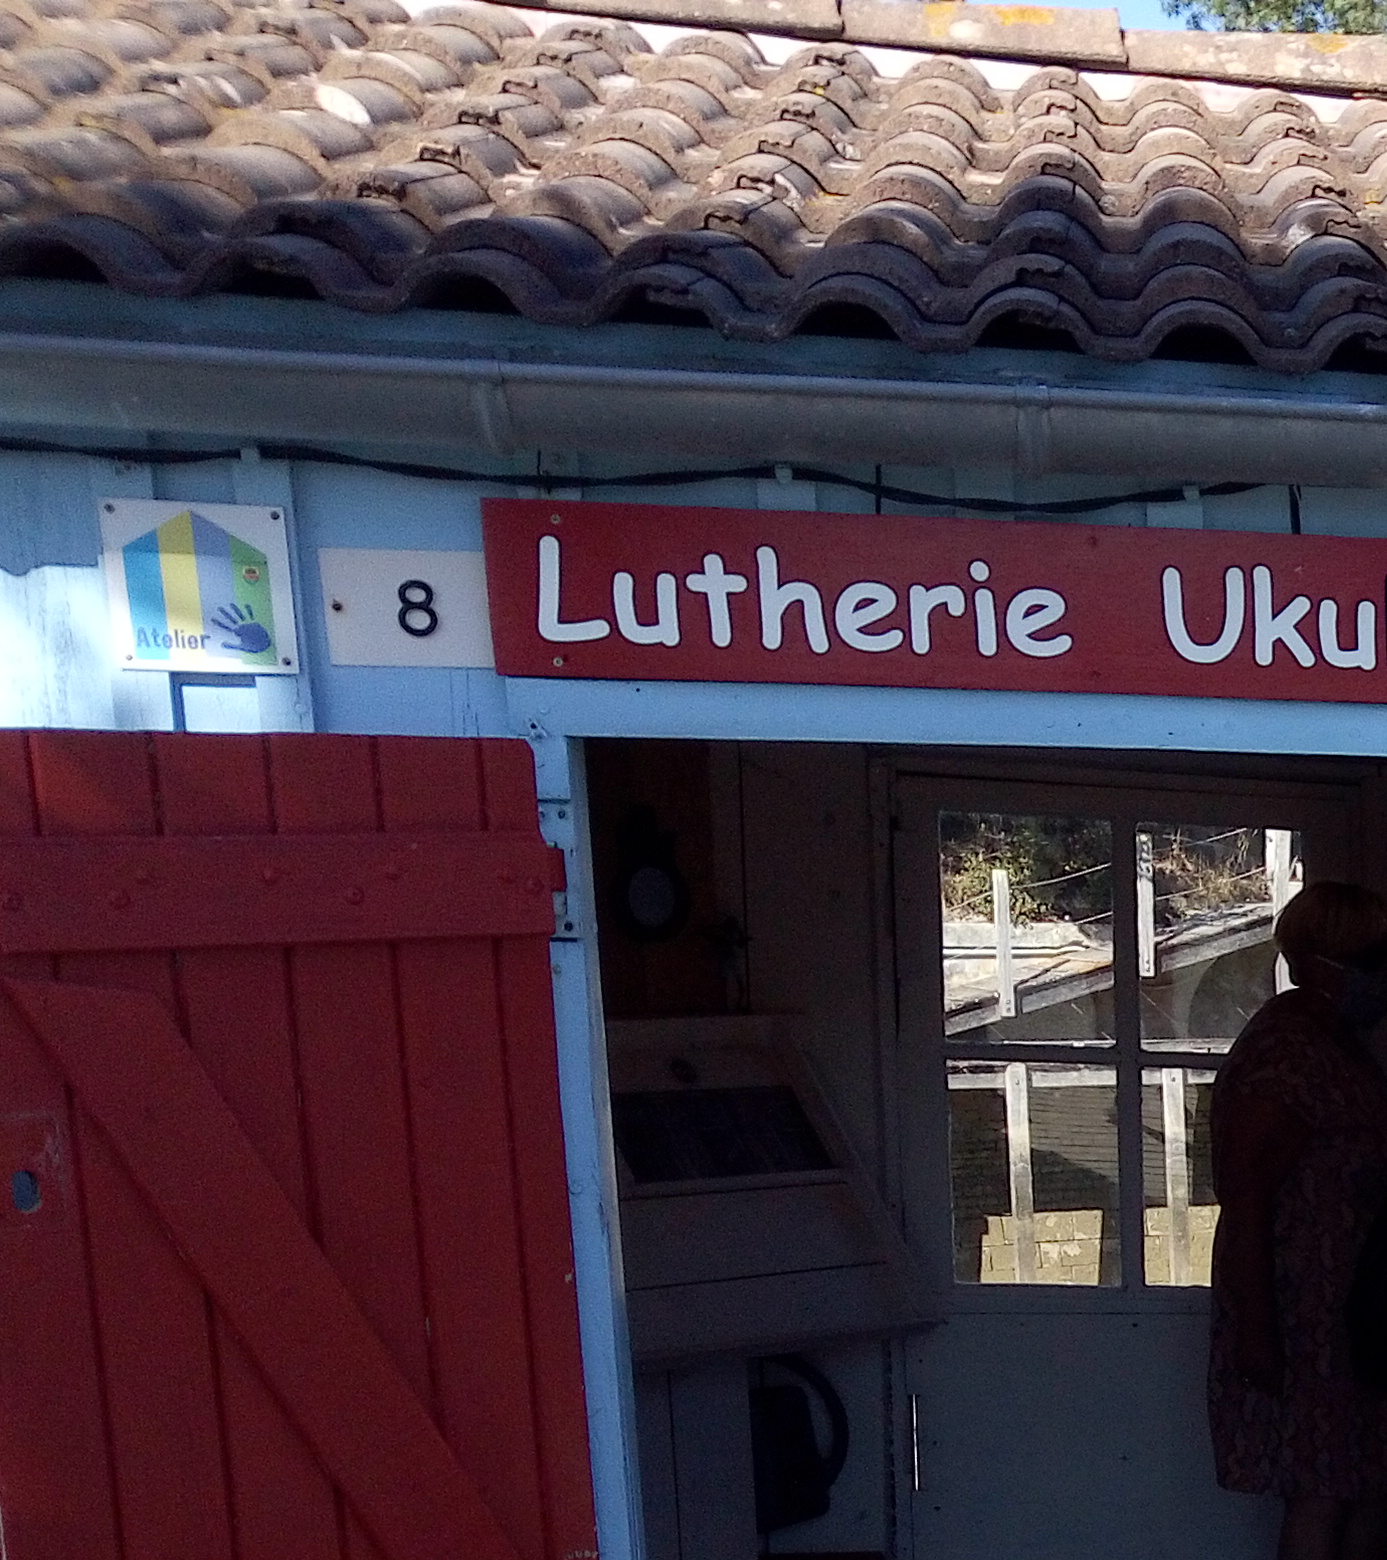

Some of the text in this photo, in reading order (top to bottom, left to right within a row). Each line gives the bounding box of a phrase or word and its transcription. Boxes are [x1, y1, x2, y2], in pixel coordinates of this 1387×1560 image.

[397, 579, 439, 638] 8
[538, 535, 1072, 657] Lutherie
[136, 627, 211, 650] Atelier
